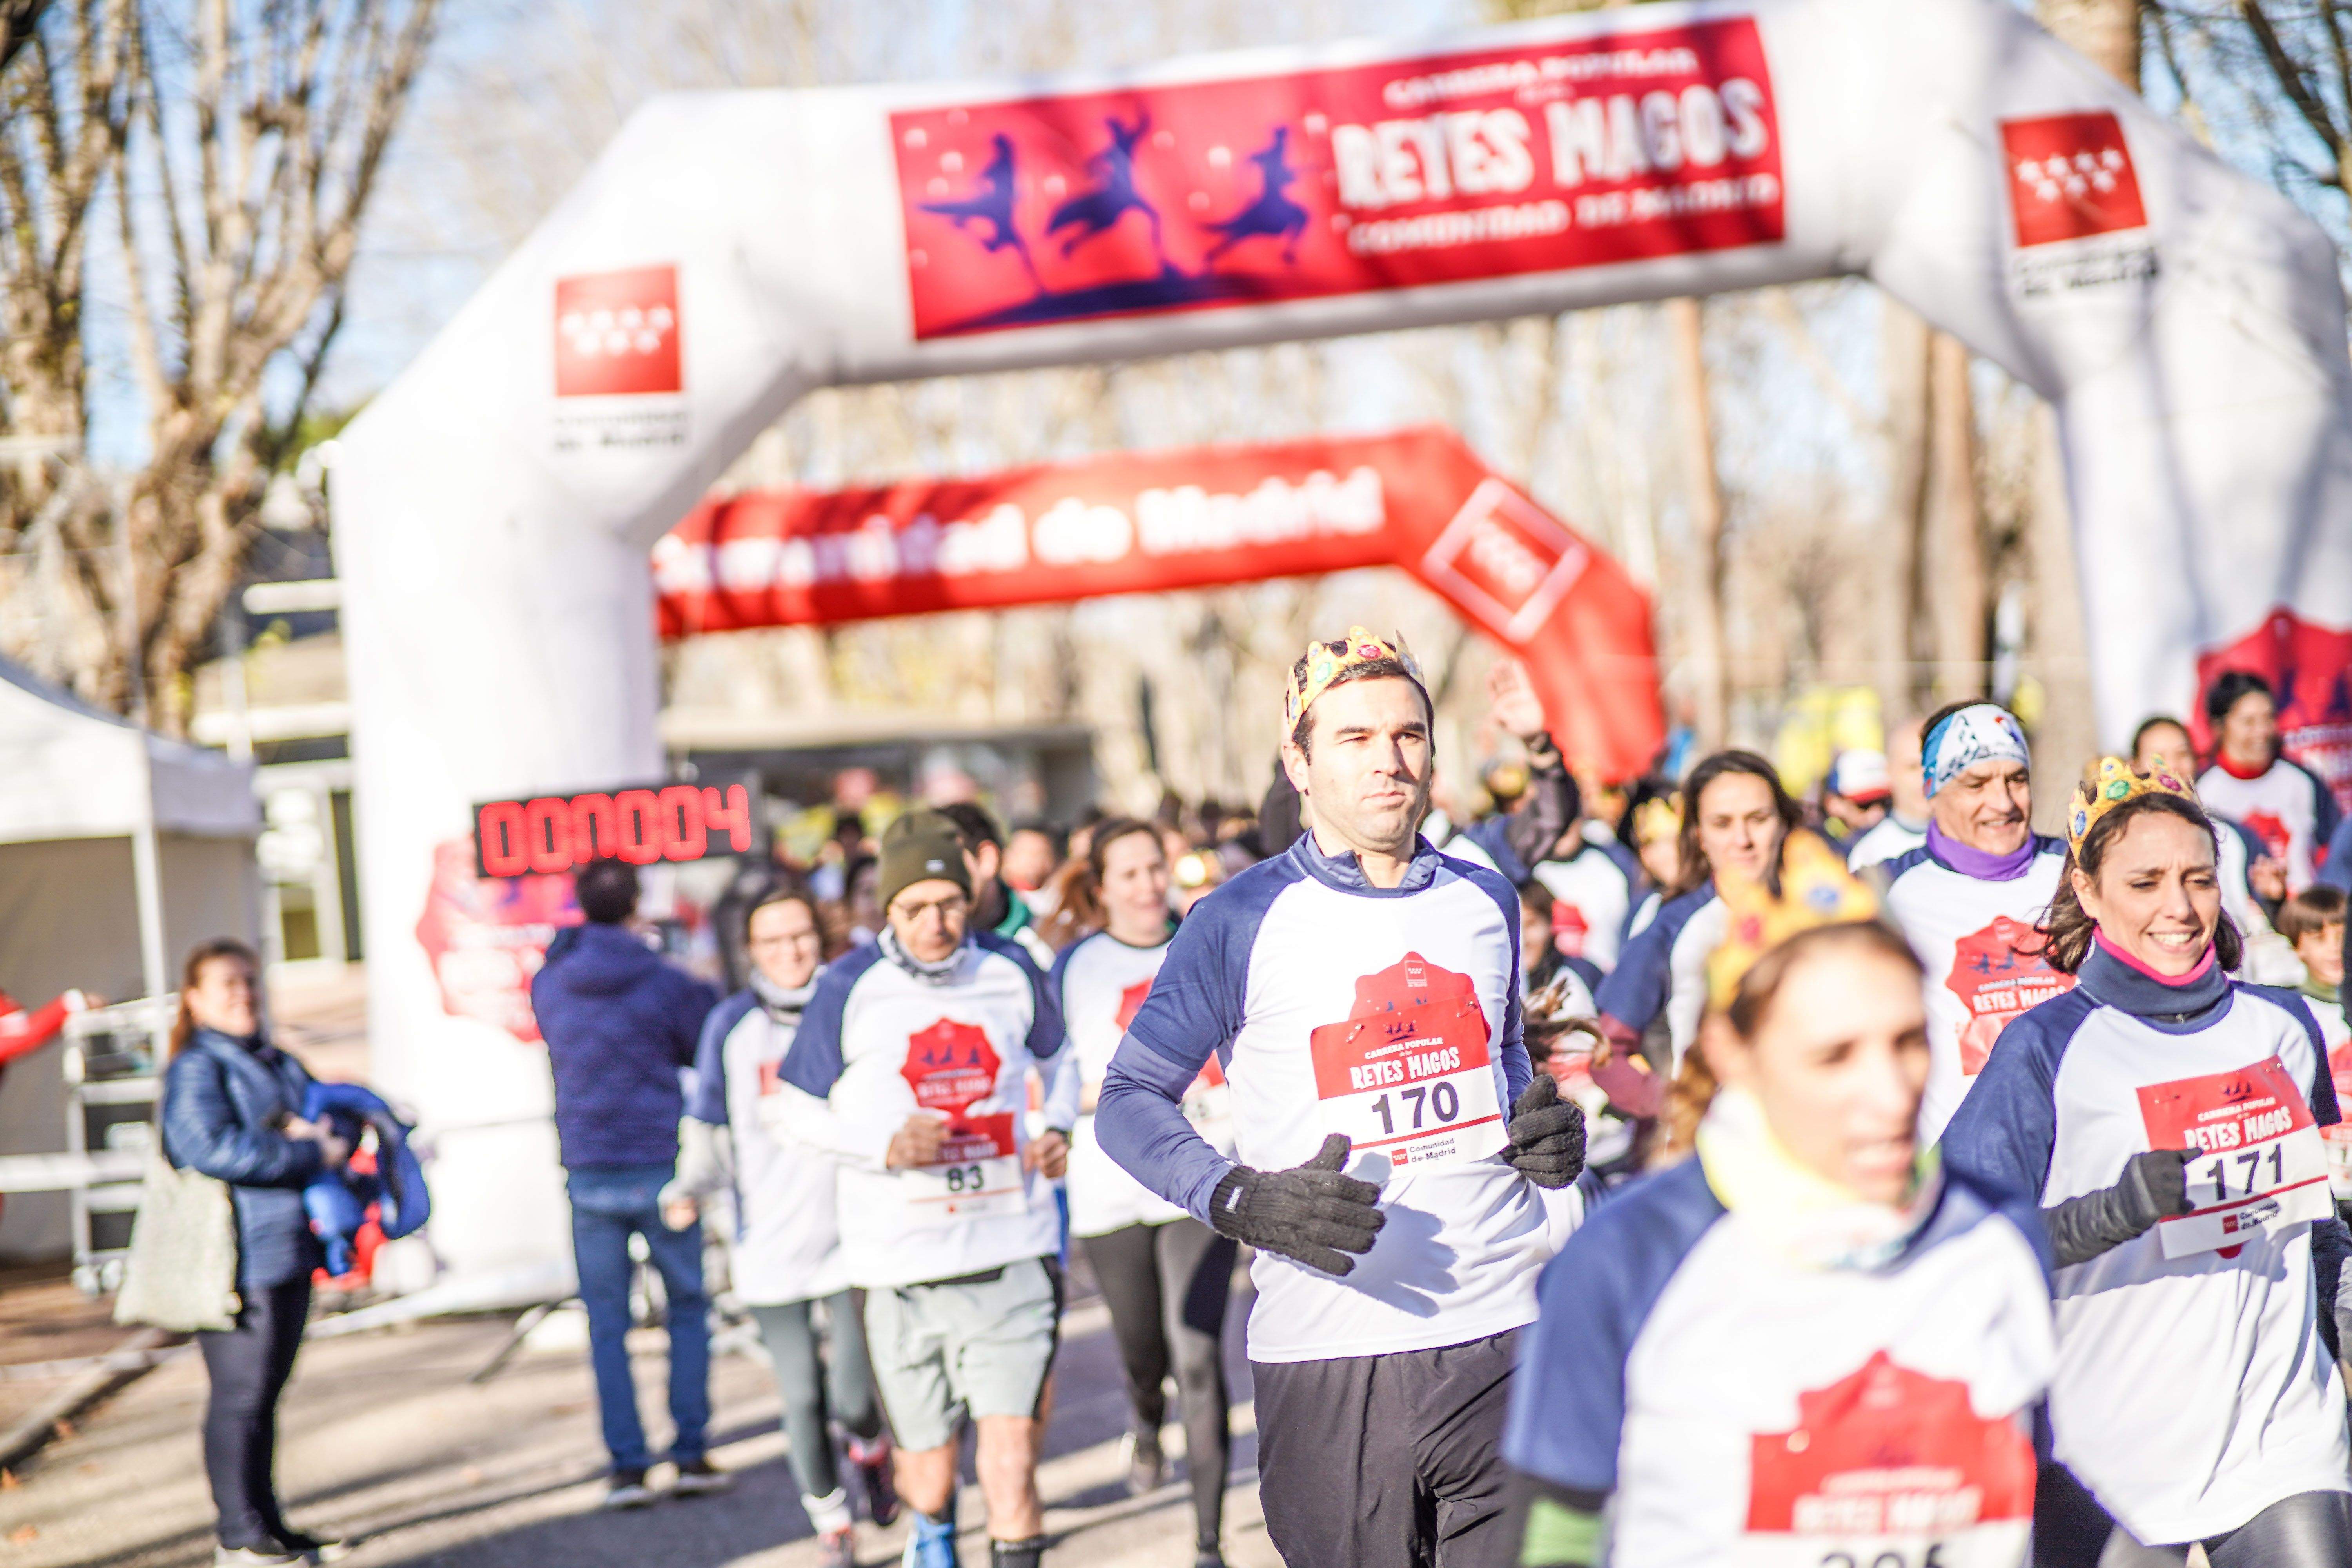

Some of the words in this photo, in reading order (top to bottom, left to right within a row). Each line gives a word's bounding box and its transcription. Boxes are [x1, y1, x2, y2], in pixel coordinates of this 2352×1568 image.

[1330, 107, 1535, 212] REYES
[1544, 76, 1770, 190] MAGOS
[1972, 990, 2017, 1013] REYES
[1364, 1043, 1405, 1060] CARRERA
[1404, 1037, 1443, 1049] POPULAR
[1349, 1059, 1405, 1089] REYES
[1406, 1046, 1461, 1080] MAGOS
[1372, 1081, 1459, 1134] 170
[2197, 1104, 2242, 1122] CARRERA
[2242, 1096, 2277, 1111] POPULAR
[2243, 1105, 2293, 1143] MAGOS
[1410, 1138, 1454, 1153] Comunidad
[1426, 1147, 1456, 1160] Madrid
[947, 1165, 984, 1192] 83
[2207, 1143, 2281, 1201] 171
